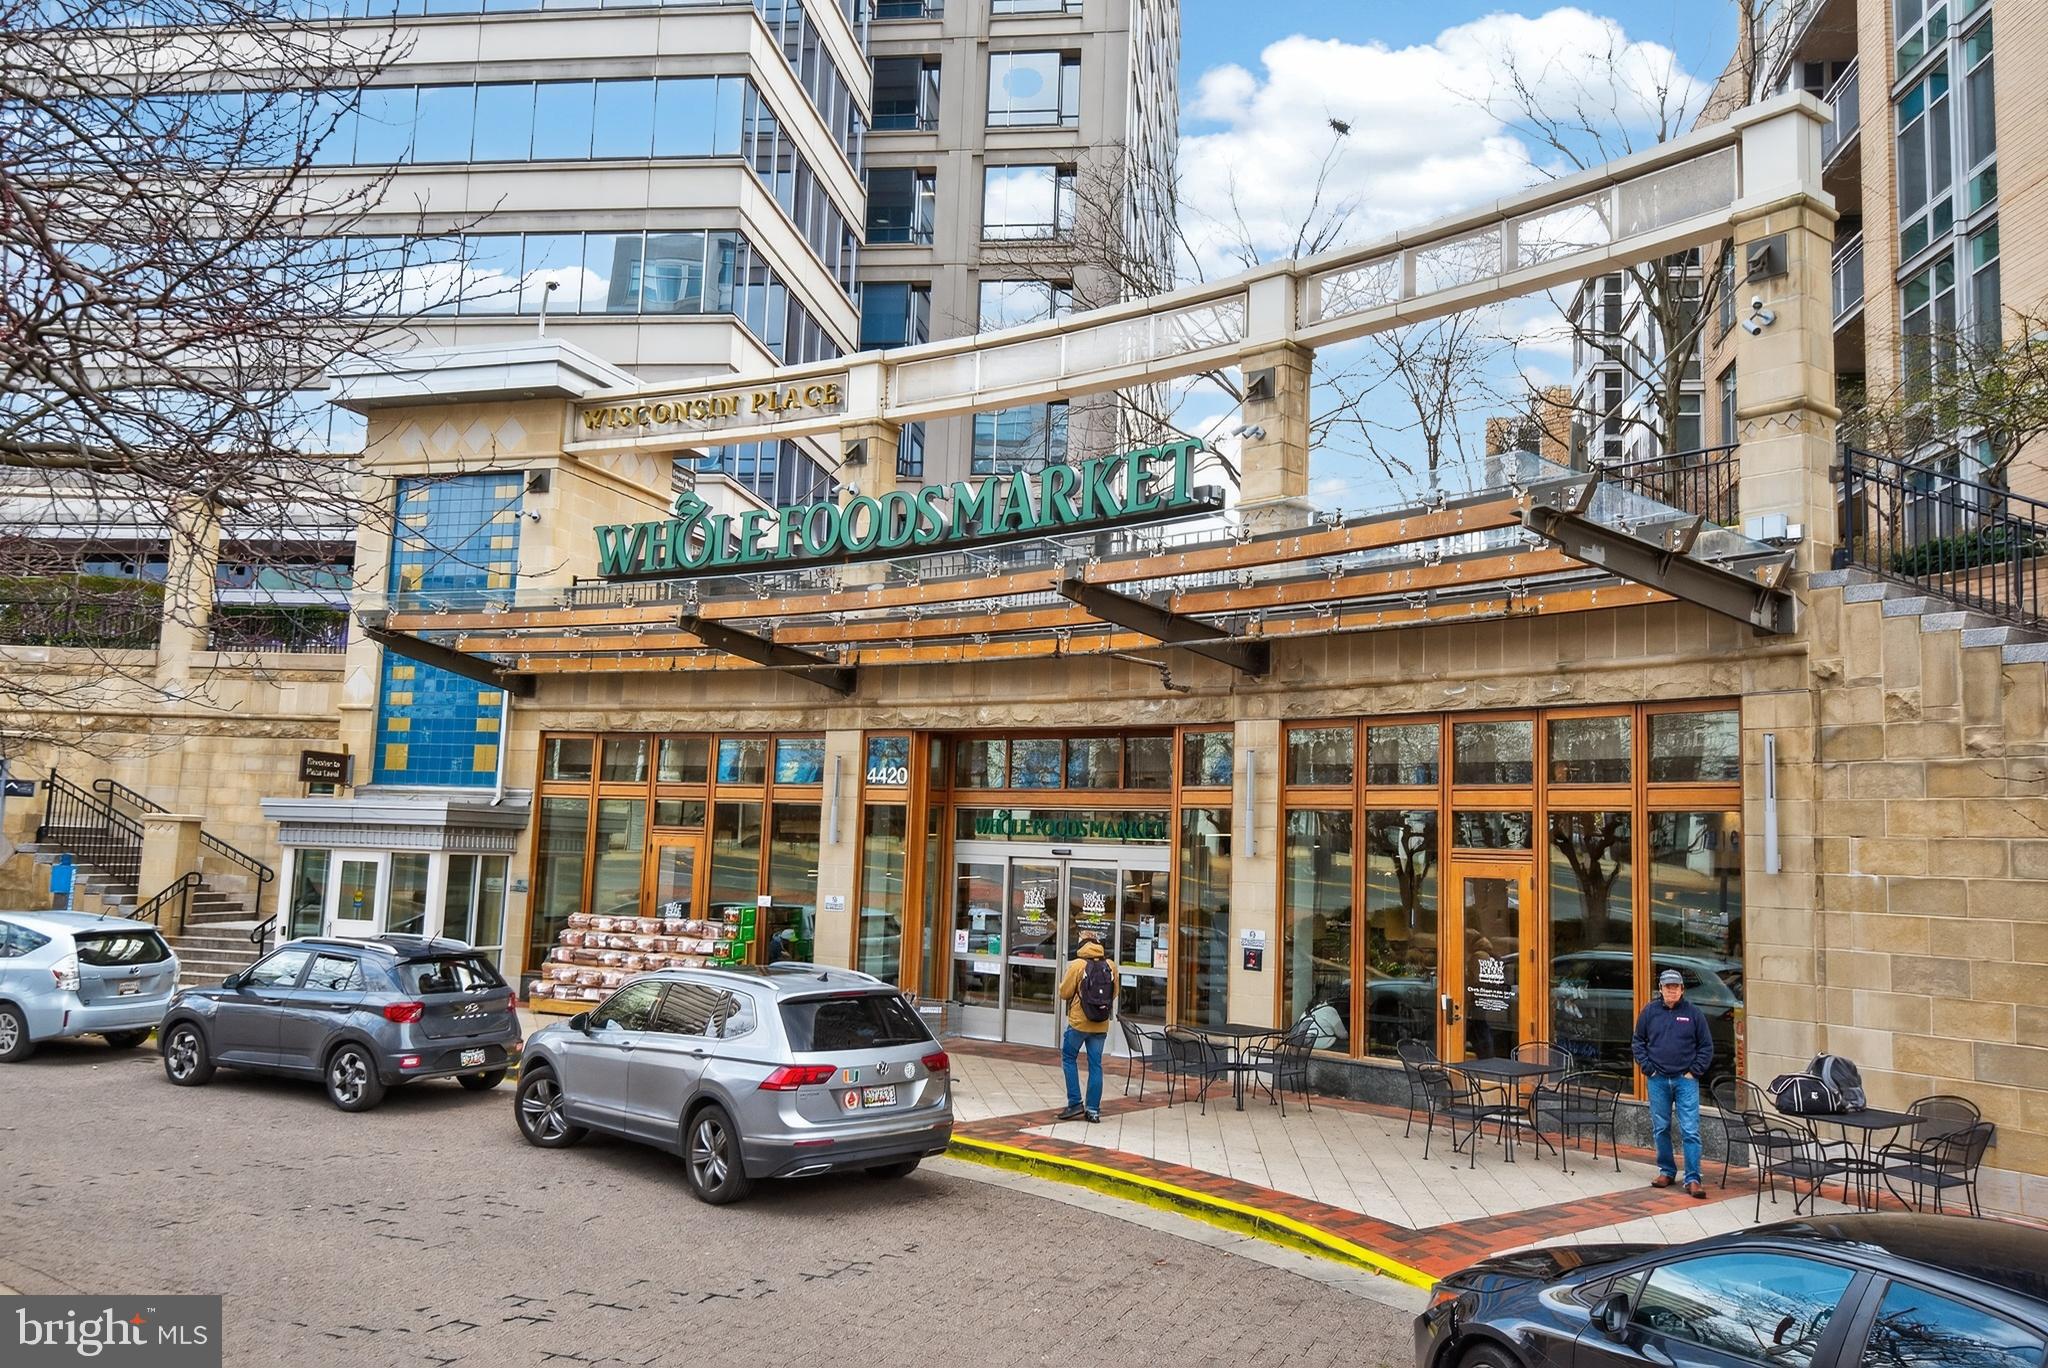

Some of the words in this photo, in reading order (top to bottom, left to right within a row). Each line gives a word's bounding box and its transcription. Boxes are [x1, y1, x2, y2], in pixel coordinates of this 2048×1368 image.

[583, 395, 741, 430] WISCONSIN
[751, 383, 841, 413] PLACE
[866, 767, 908, 785] 4420
